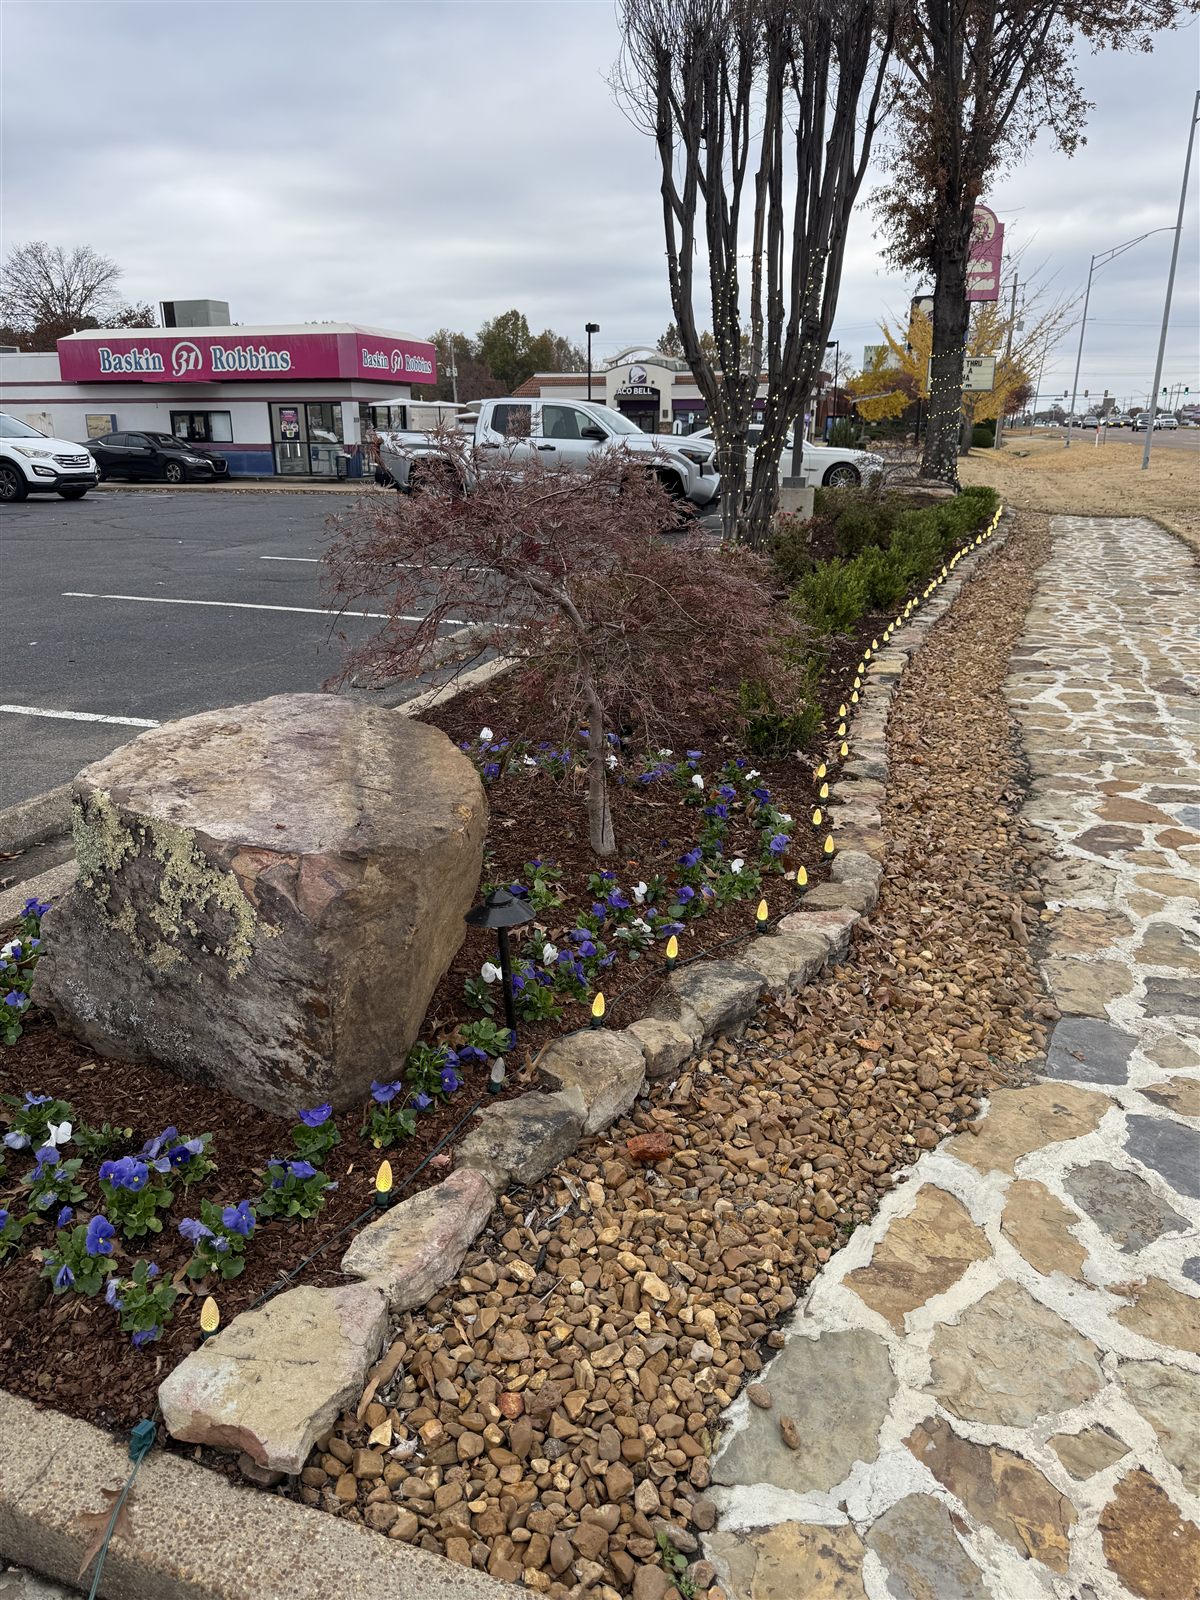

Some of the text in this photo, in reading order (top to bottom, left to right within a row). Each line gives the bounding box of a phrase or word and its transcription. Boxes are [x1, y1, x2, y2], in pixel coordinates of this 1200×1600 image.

[98, 348, 164, 372] Baskin
[210, 345, 291, 371] Robbins
[362, 349, 389, 369] Baskin
[405, 354, 432, 373] Robbins
[615, 387, 652, 395] ACO BELL
